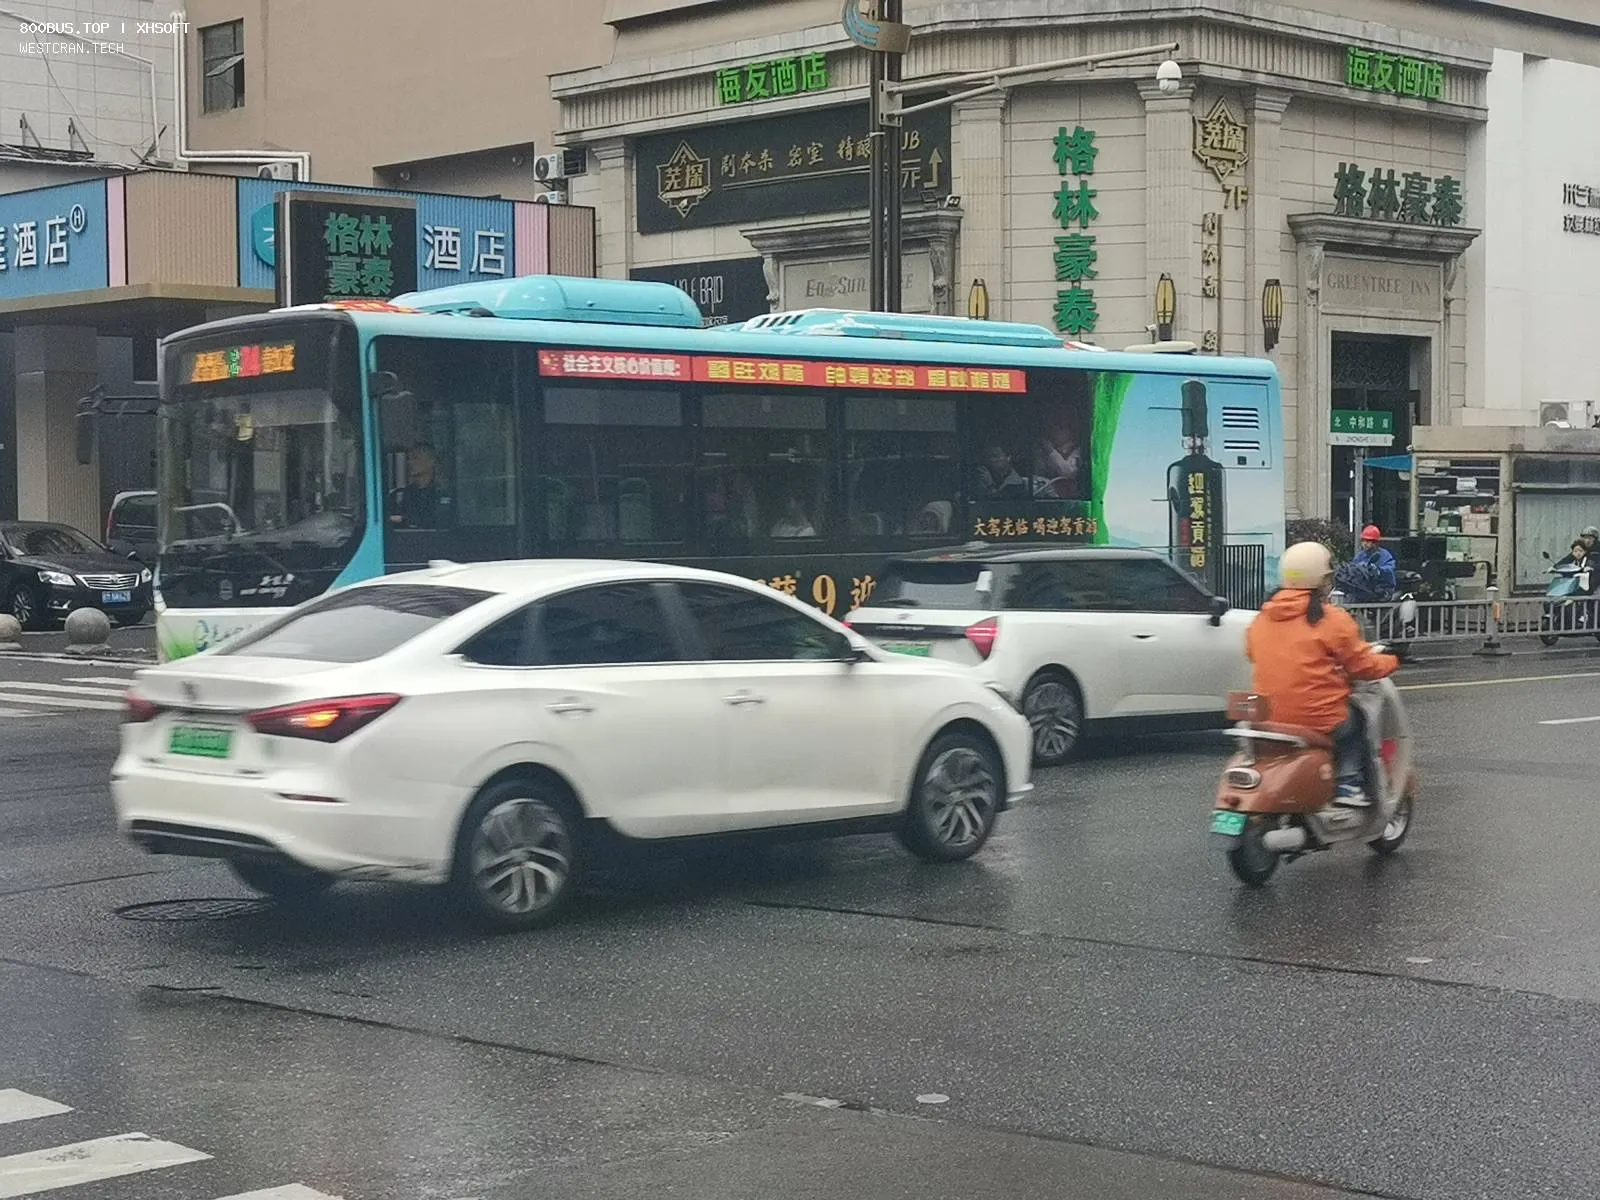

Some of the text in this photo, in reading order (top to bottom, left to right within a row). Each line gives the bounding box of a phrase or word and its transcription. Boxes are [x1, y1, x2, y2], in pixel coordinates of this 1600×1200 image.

[1222, 184, 1248, 210] 7F
[1333, 161, 1464, 227] 格林豪泰
[323, 211, 394, 256] 格林
[423, 224, 505, 275] 酒店
[1053, 126, 1100, 335] 格林豪泰
[325, 255, 394, 296] 豪泰
[812, 574, 837, 616] 9
